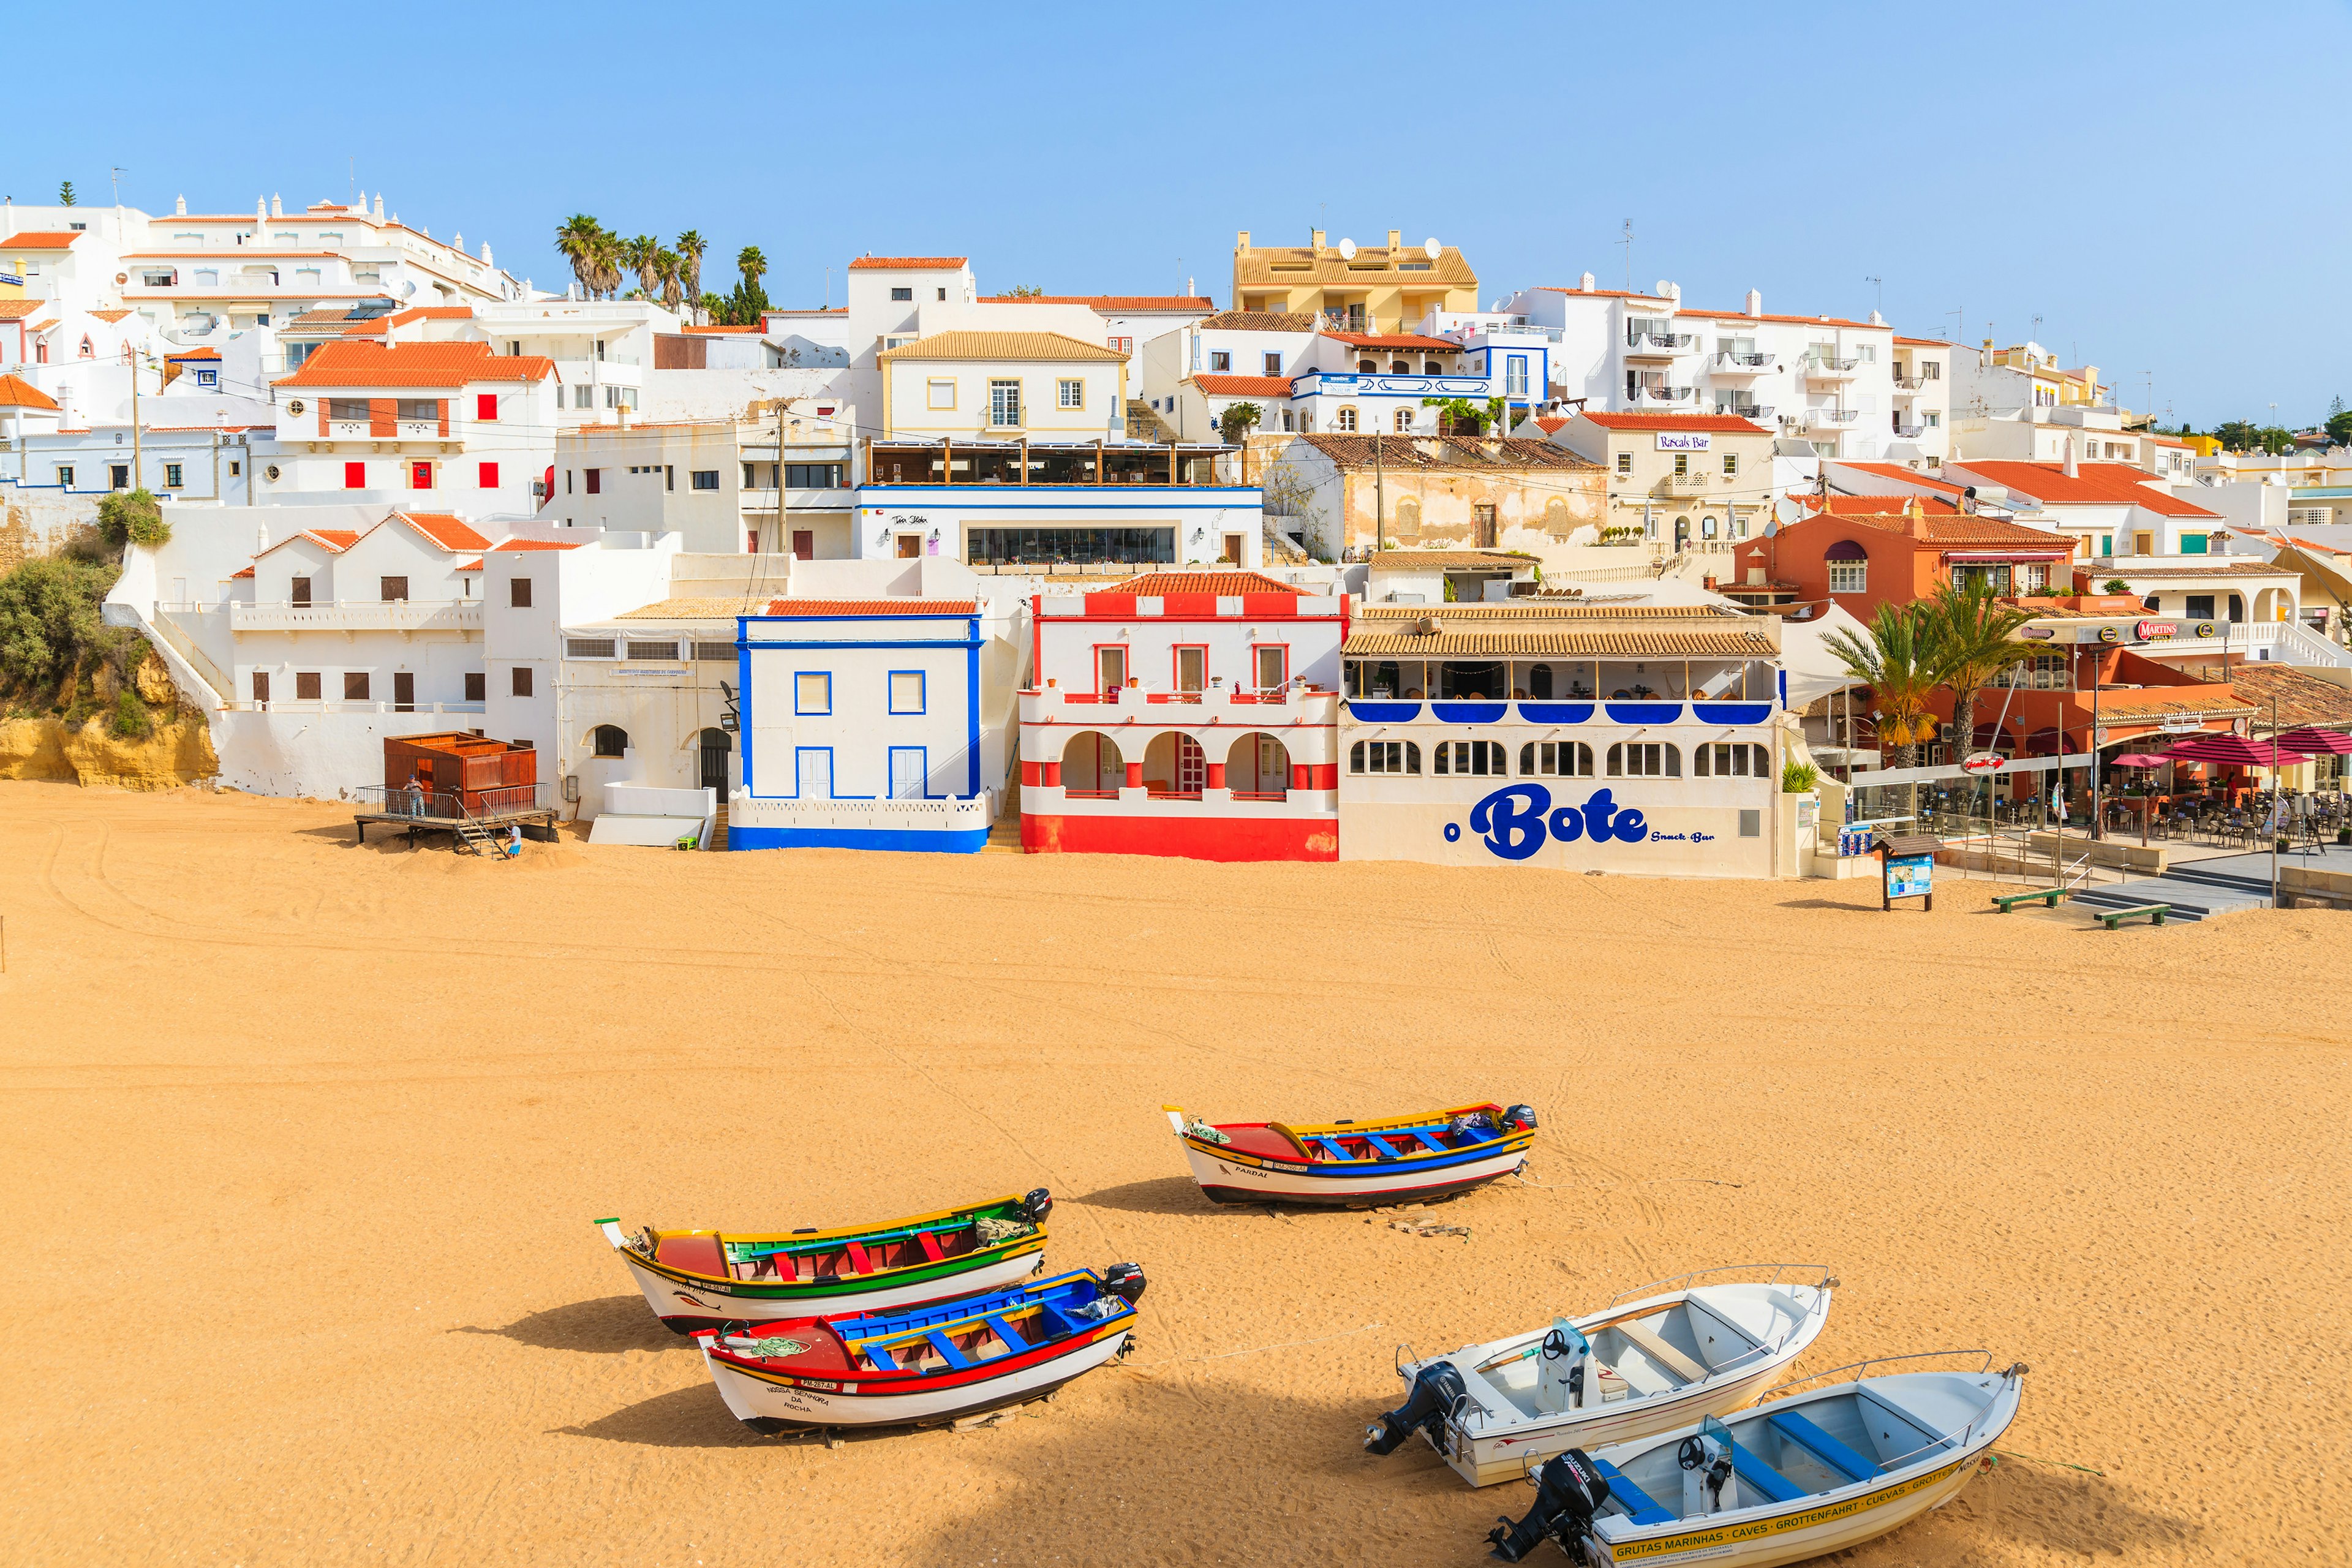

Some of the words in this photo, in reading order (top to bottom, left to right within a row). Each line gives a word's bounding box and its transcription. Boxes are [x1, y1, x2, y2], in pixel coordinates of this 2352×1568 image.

[1660, 435, 1690, 448] Rascals
[1692, 437, 1709, 448] Bar
[892, 515, 907, 524] Tia
[910, 515, 928, 524] Ilda
[2141, 624, 2177, 636] MARTINS
[1470, 783, 1648, 860] Bote
[1235, 1166, 1268, 1178] PARDAL
[1274, 1163, 1306, 1172] PM-266-AL
[704, 1282, 731, 1293] PM-567-AL
[1444, 1381, 1456, 1398] YAMAHA
[794, 1389, 829, 1406] SENHORA
[784, 1402, 812, 1413] ROCHA
[1566, 1453, 1591, 1482] SUZUKI
[1617, 1542, 1662, 1556] GRUTAS
[1665, 1532, 1723, 1549] MARINHAS
[1732, 1524, 1768, 1538] CAVES
[1776, 1502, 1858, 1529] GROTTENFAHRT
[1866, 1487, 1905, 1506] CUEVAS
[1913, 1466, 1954, 1489] GROTTES
